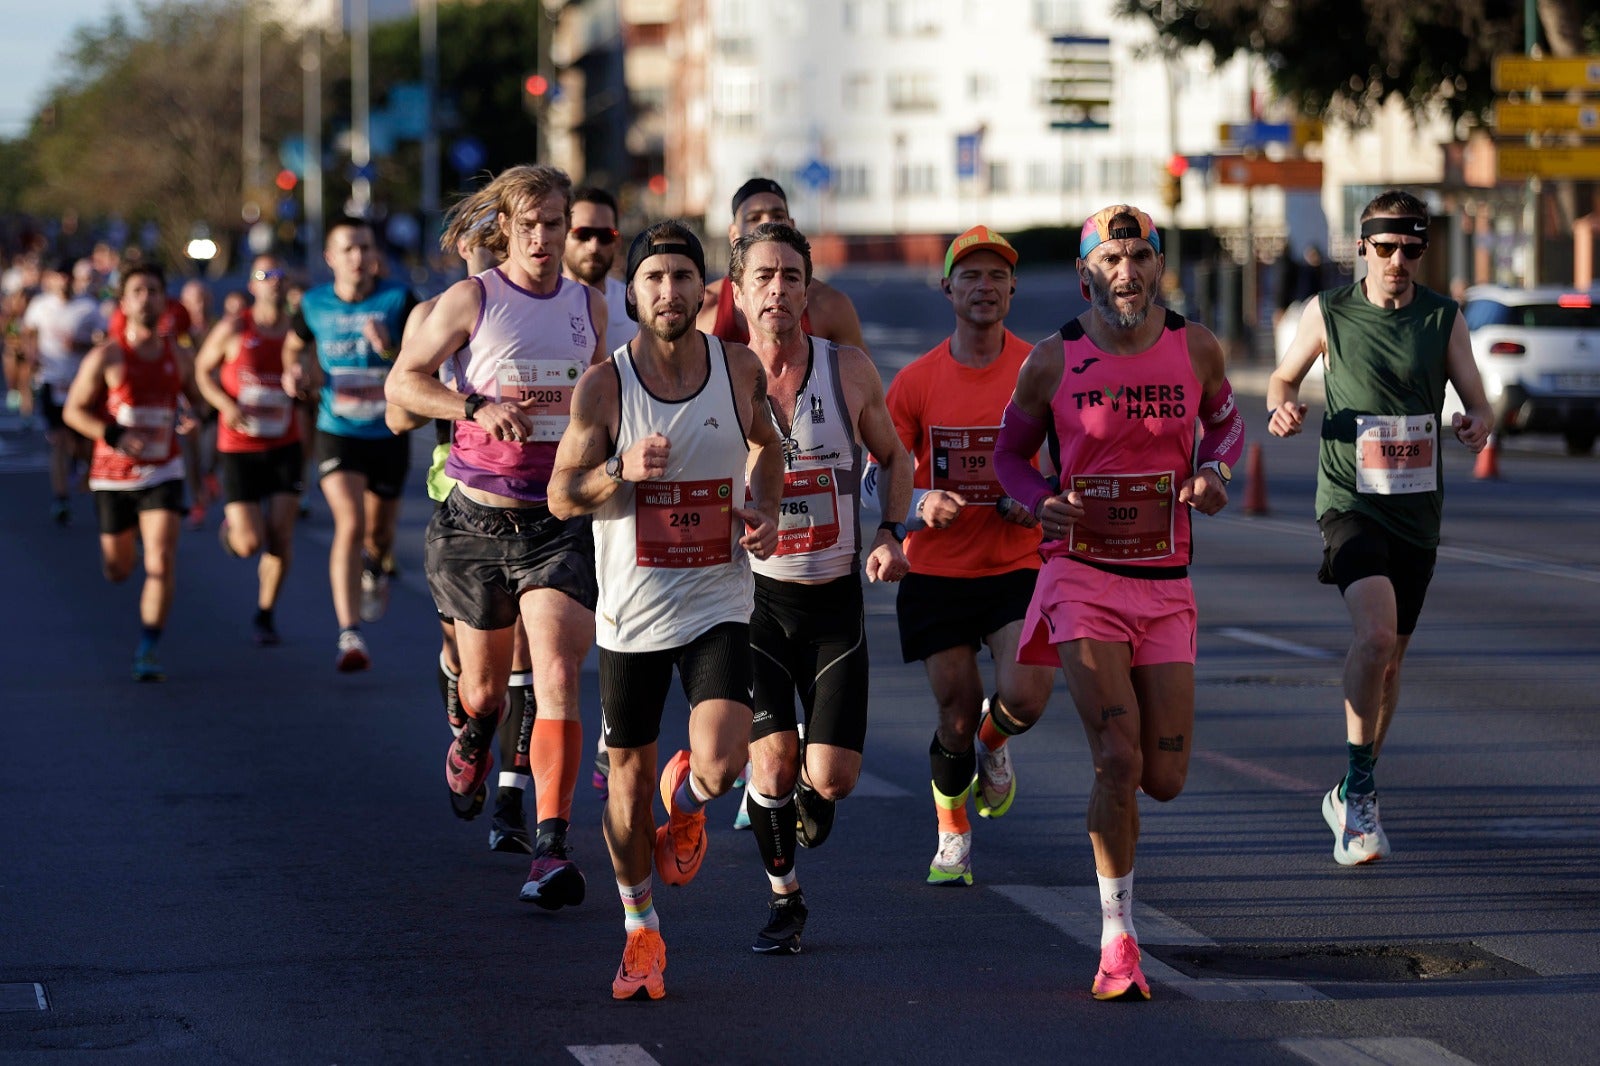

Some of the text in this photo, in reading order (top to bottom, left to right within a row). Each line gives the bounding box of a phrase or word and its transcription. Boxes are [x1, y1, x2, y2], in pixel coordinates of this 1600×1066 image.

[1126, 402, 1186, 420] HARO
[1381, 445, 1420, 457] 10226
[936, 456, 948, 470] VIP
[960, 455, 987, 469] 199
[792, 479, 810, 487] 42K
[691, 488, 709, 497] 42K
[669, 512, 701, 528] 249
[1107, 506, 1139, 521] 300
